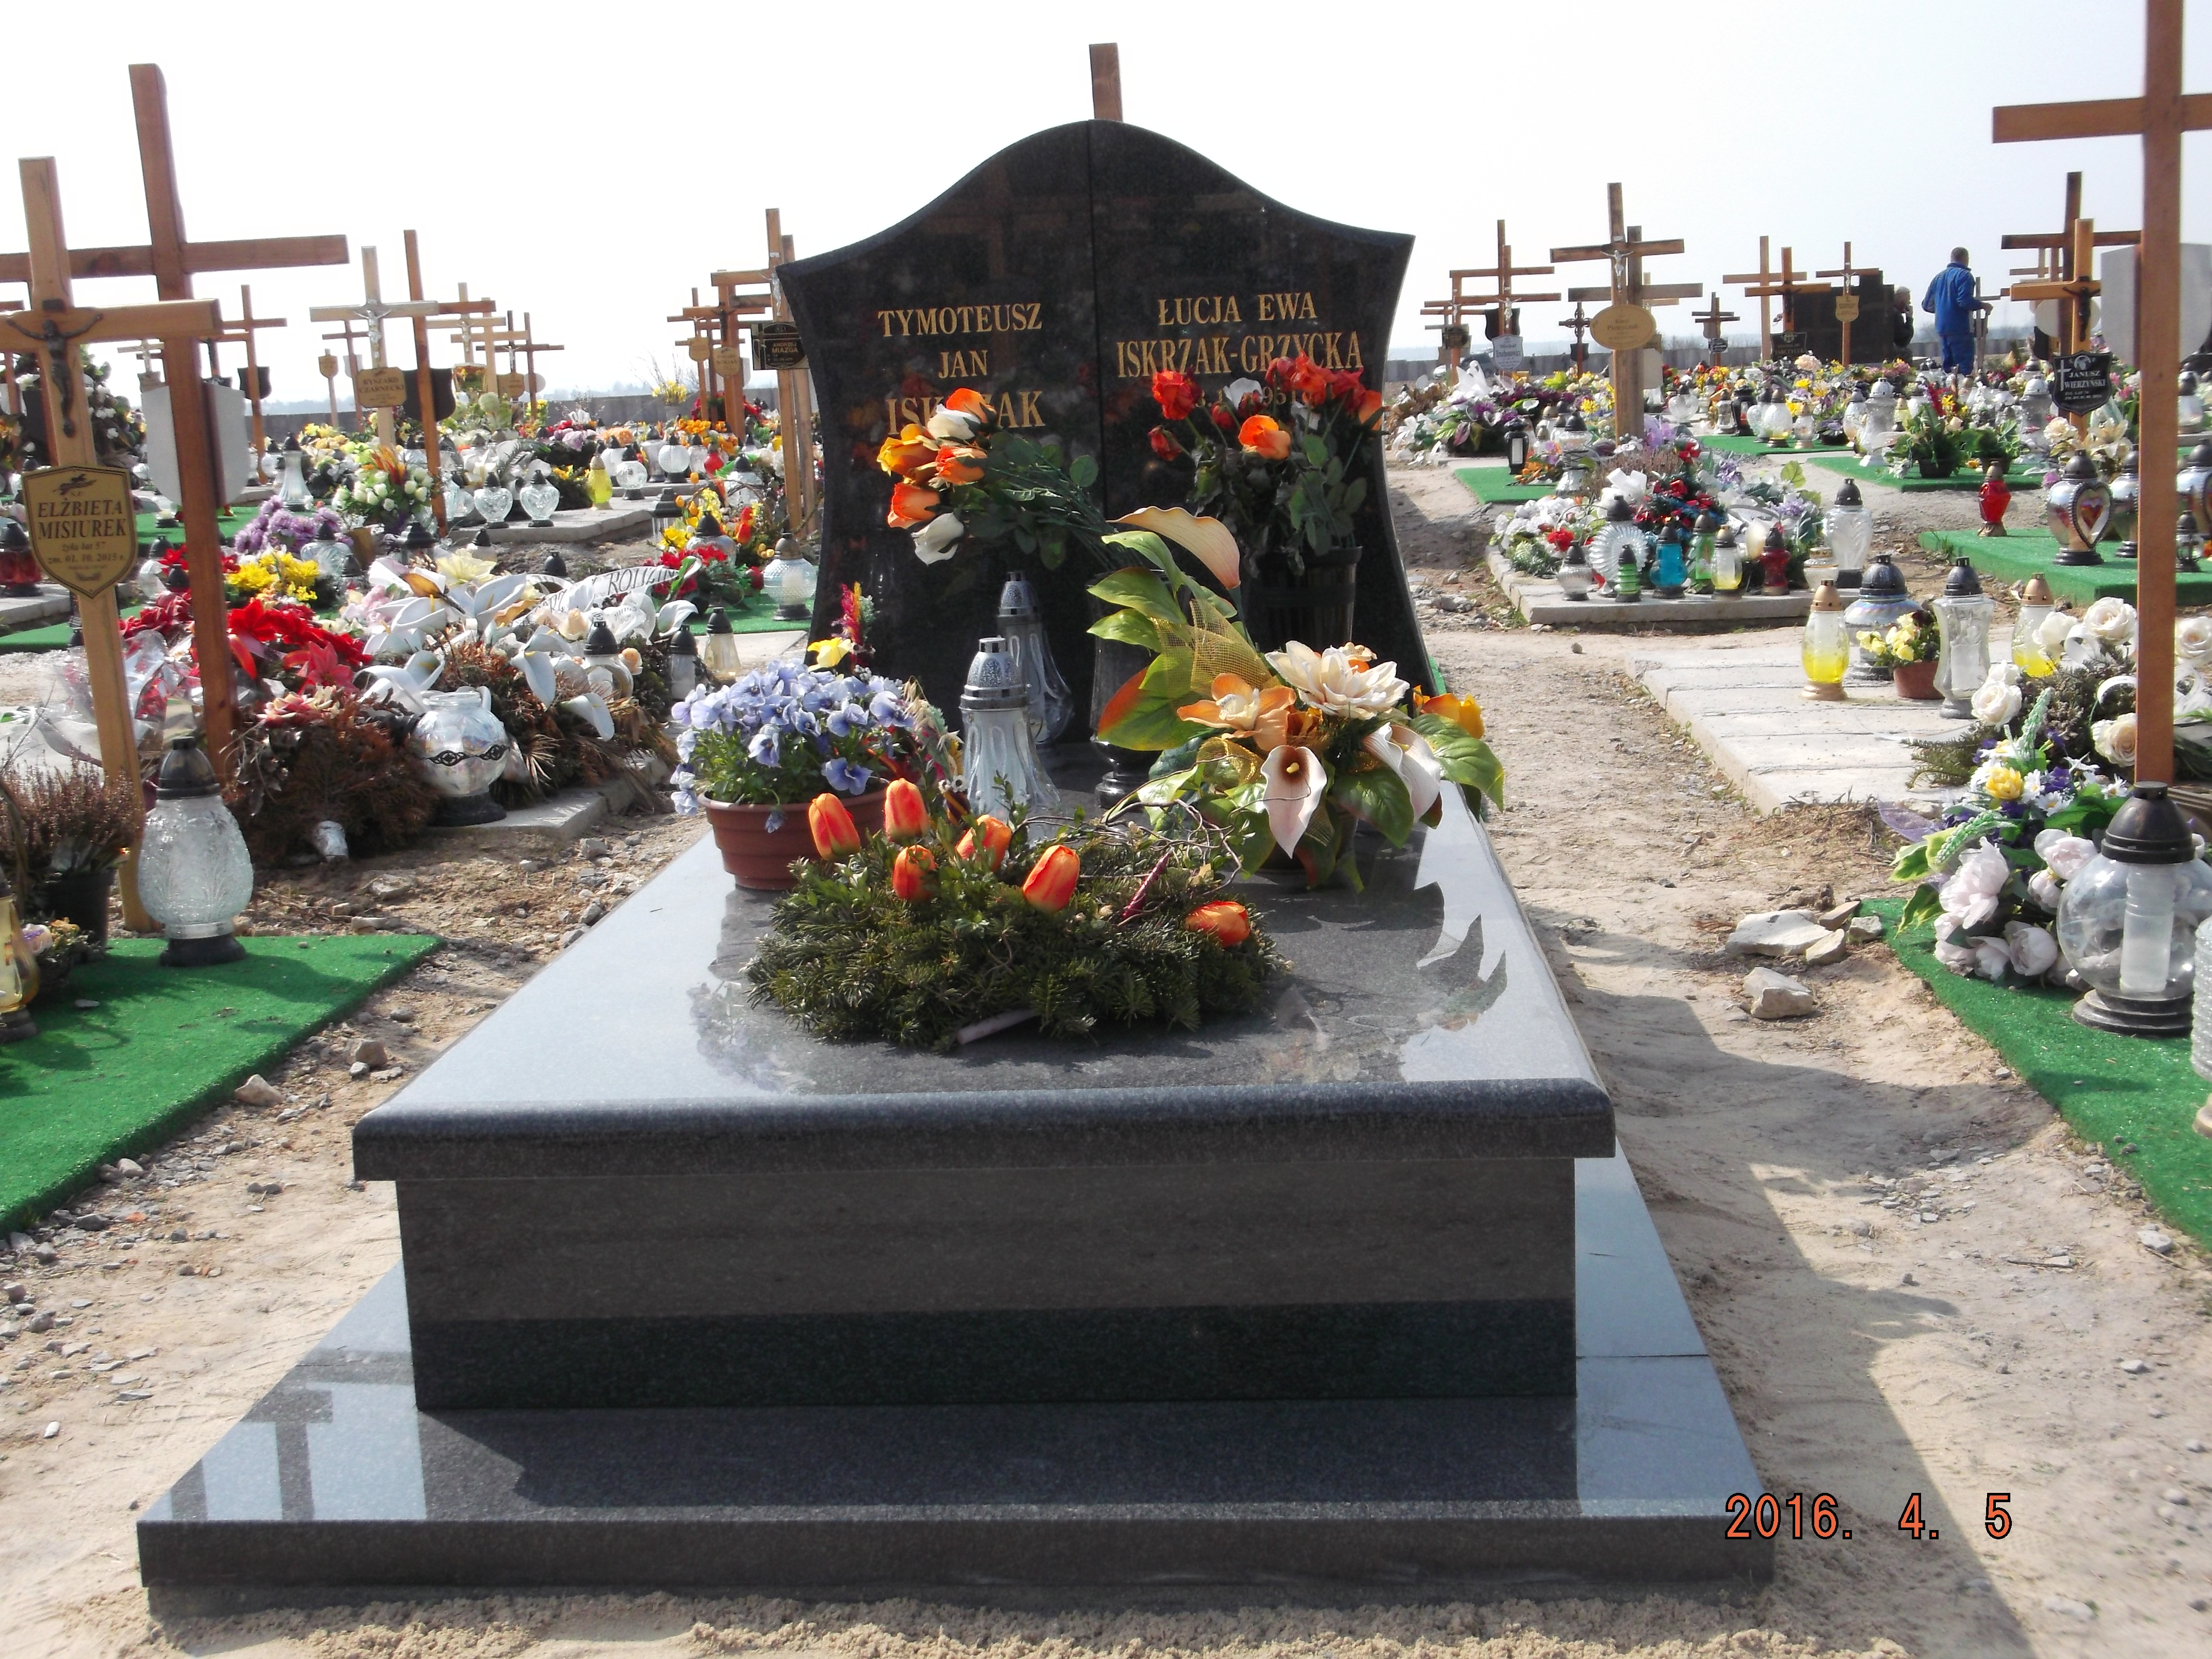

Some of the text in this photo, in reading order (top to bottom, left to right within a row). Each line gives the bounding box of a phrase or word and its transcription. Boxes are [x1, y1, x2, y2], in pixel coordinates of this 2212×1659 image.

[878, 302, 1043, 337] TYMOTEUSZ
[1158, 291, 1317, 326] ŁUCJA EWA
[938, 350, 988, 379] JAN
[1117, 330, 1363, 378] ISKRZAK-GRZYCKA
[363, 377, 399, 385] RYSZARD
[38, 498, 123, 517] ELŻBIETA
[38, 518, 126, 539] MISIUREK
[82, 542, 93, 550] lat
